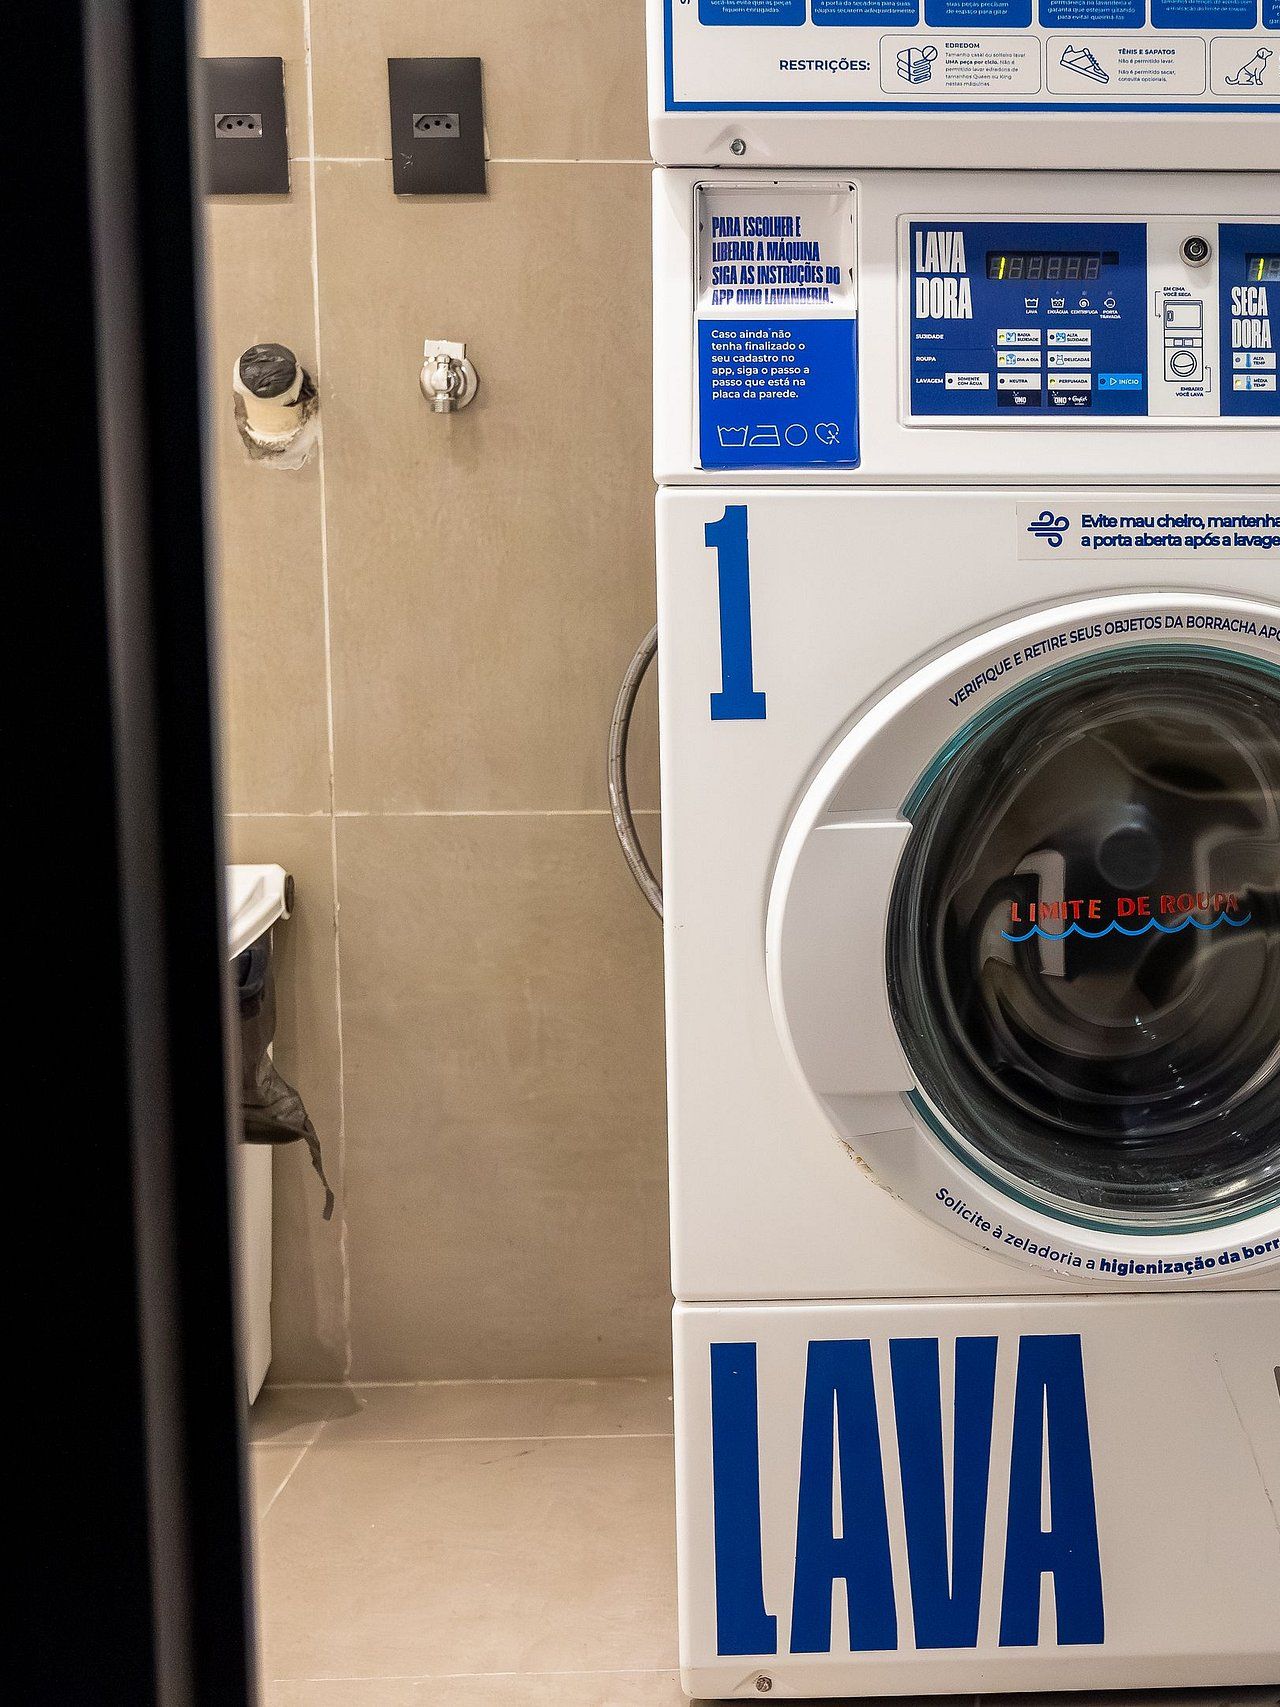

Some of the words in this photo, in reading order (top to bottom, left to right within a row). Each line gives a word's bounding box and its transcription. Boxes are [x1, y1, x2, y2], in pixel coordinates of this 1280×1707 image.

[779, 58, 870, 73] RESTRIÇÕES:
[712, 216, 741, 237] PARA
[744, 216, 793, 237] ESCOLHER
[796, 216, 801, 237] E
[712, 242, 755, 262] LIBERAR
[757, 242, 764, 261] A
[767, 238, 820, 263] MÁQUINA
[915, 231, 966, 273] LAVA
[712, 266, 737, 285] SIGA
[740, 266, 755, 284] AS
[757, 262, 823, 286] INSTRUÇÕES
[826, 266, 840, 285] DO
[712, 289, 733, 305] APP
[736, 289, 762, 305] OMO
[765, 288, 833, 304] LAVANDERIA.
[915, 277, 973, 319] DORA
[1231, 286, 1268, 316] SECA
[711, 330, 736, 338] Caso
[740, 330, 768, 338] ainda
[1231, 319, 1272, 349] DORA
[712, 342, 742, 350] tenha
[745, 342, 795, 350] finalizado
[733, 354, 778, 362] cadastro
[737, 367, 758, 376] siga
[771, 368, 800, 376] passo
[768, 378, 790, 386] está
[712, 390, 740, 400] placa
[743, 390, 756, 398] da
[759, 390, 798, 400] parede.
[1081, 513, 1117, 528] Evite
[1120, 516, 1154, 528] mau
[1157, 513, 1205, 529] cheiro,
[1081, 536, 1090, 546] a
[1094, 535, 1132, 549] porta
[1134, 533, 1182, 547] aberta
[1185, 533, 1220, 549] após
[1222, 536, 1231, 546] a
[705, 505, 766, 720] 1
[948, 656, 1013, 708] VERIFIQUE
[1014, 652, 1023, 666] E
[1024, 634, 1068, 661] RETIRE
[1069, 624, 1102, 644] SEUS
[1104, 616, 1162, 635] OBJETOS
[1165, 615, 1183, 629] DA
[1186, 616, 1257, 635] BORRACHA
[1010, 900, 1102, 922] LIMITE
[1117, 896, 1151, 917] DE
[1159, 891, 1240, 915] ROUPA
[935, 1187, 991, 1232] Solicite
[992, 1225, 1002, 1239] à
[1004, 1233, 1082, 1268] zeladoria
[1086, 1259, 1096, 1270] a
[1099, 1256, 1215, 1276] higienização
[1218, 1251, 1241, 1266] da
[709, 1334, 1105, 1656] LAVA
